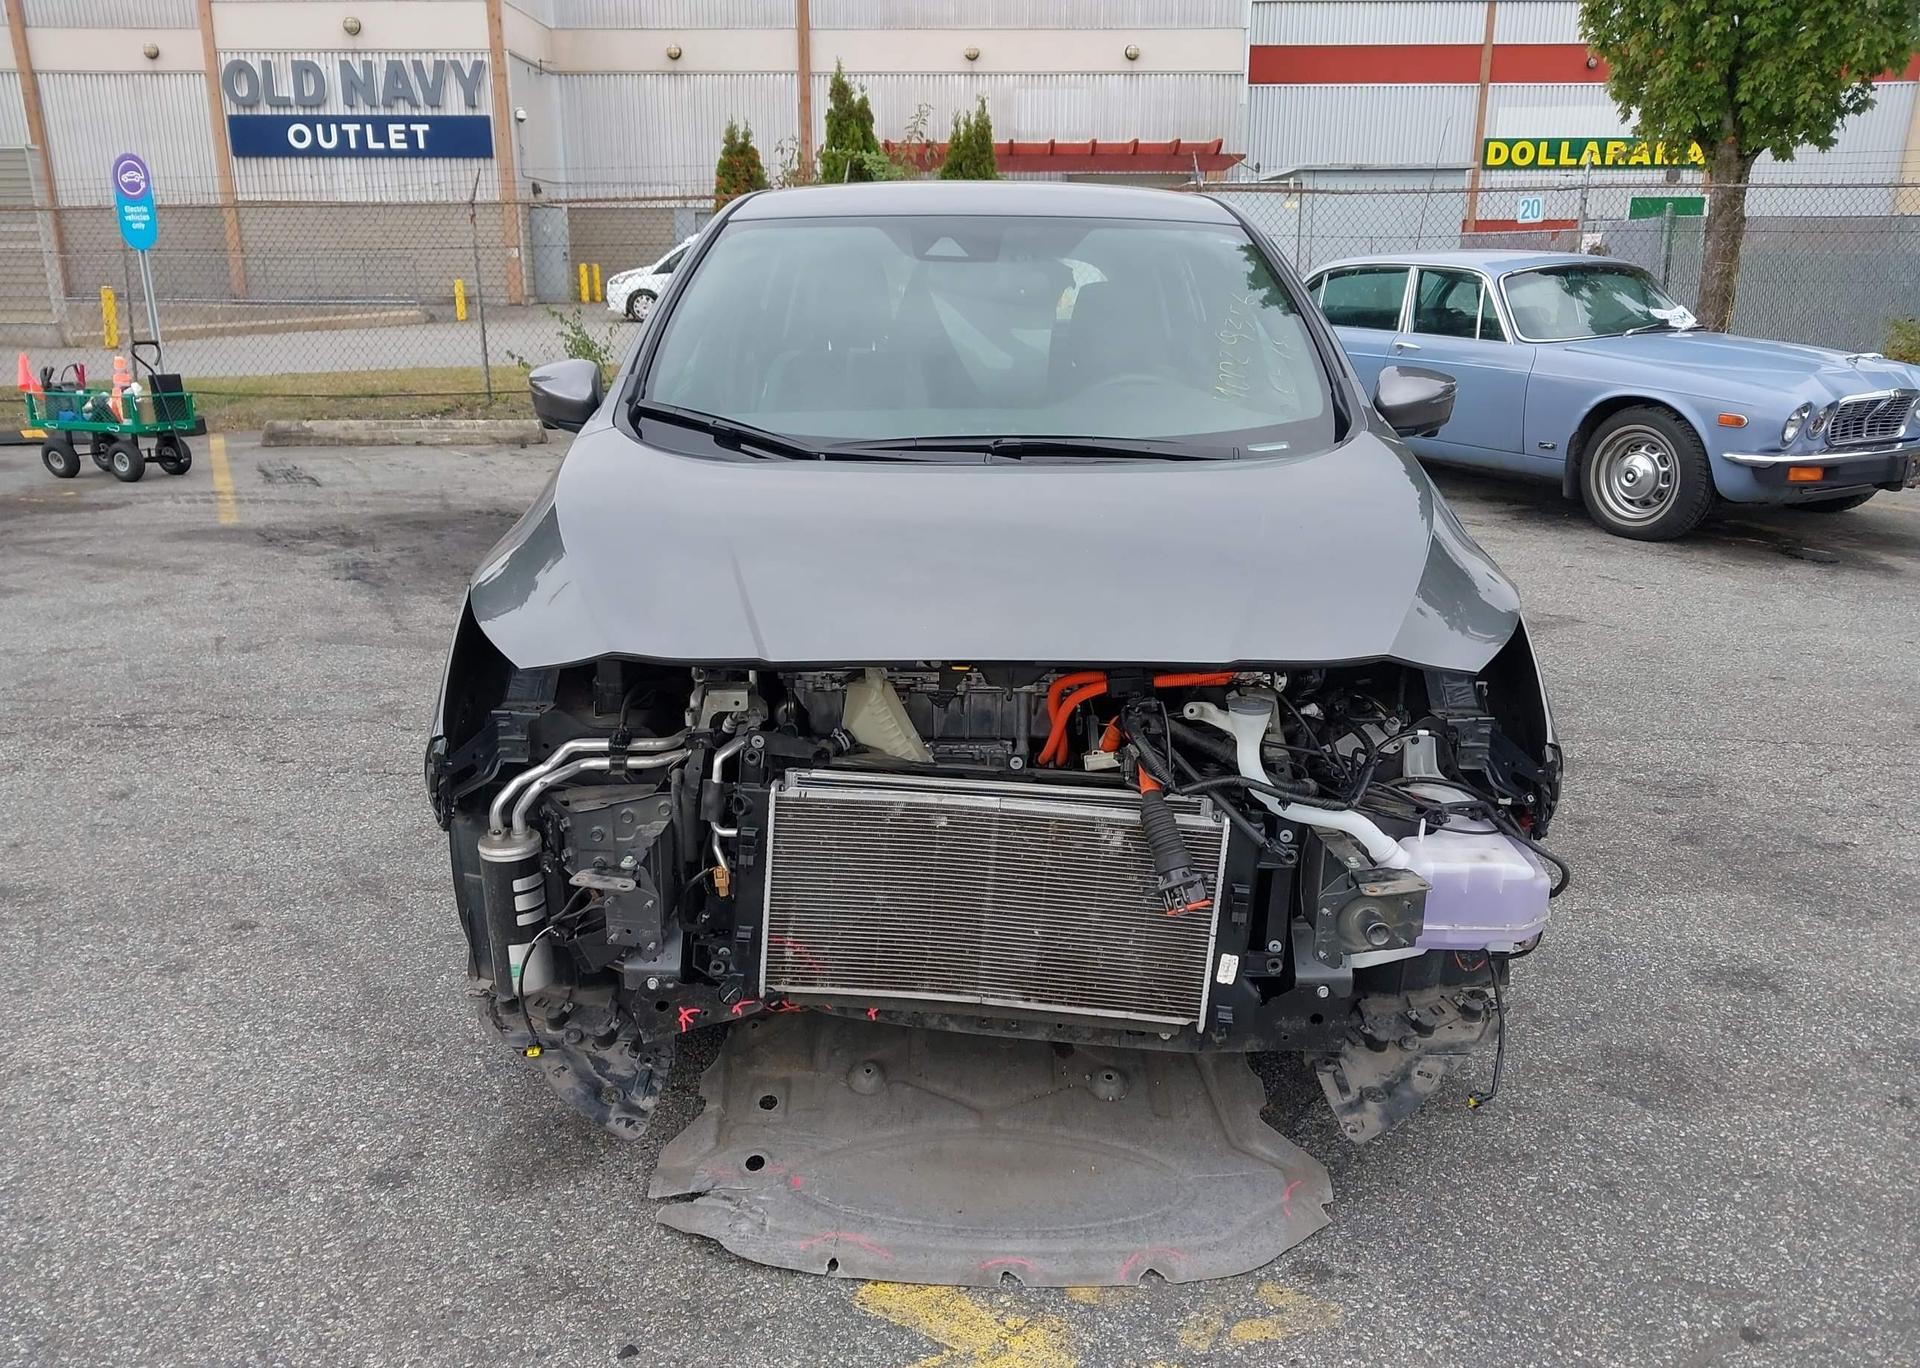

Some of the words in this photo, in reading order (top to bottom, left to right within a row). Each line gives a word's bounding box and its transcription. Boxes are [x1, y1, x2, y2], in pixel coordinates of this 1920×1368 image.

[222, 59, 327, 108] OLD
[338, 59, 486, 108] NAVY
[287, 123, 430, 150] OUTLET
[124, 205, 148, 213] Electric
[1521, 198, 1542, 220] 20
[124, 213, 151, 221] vehicles
[132, 222, 146, 230] only
